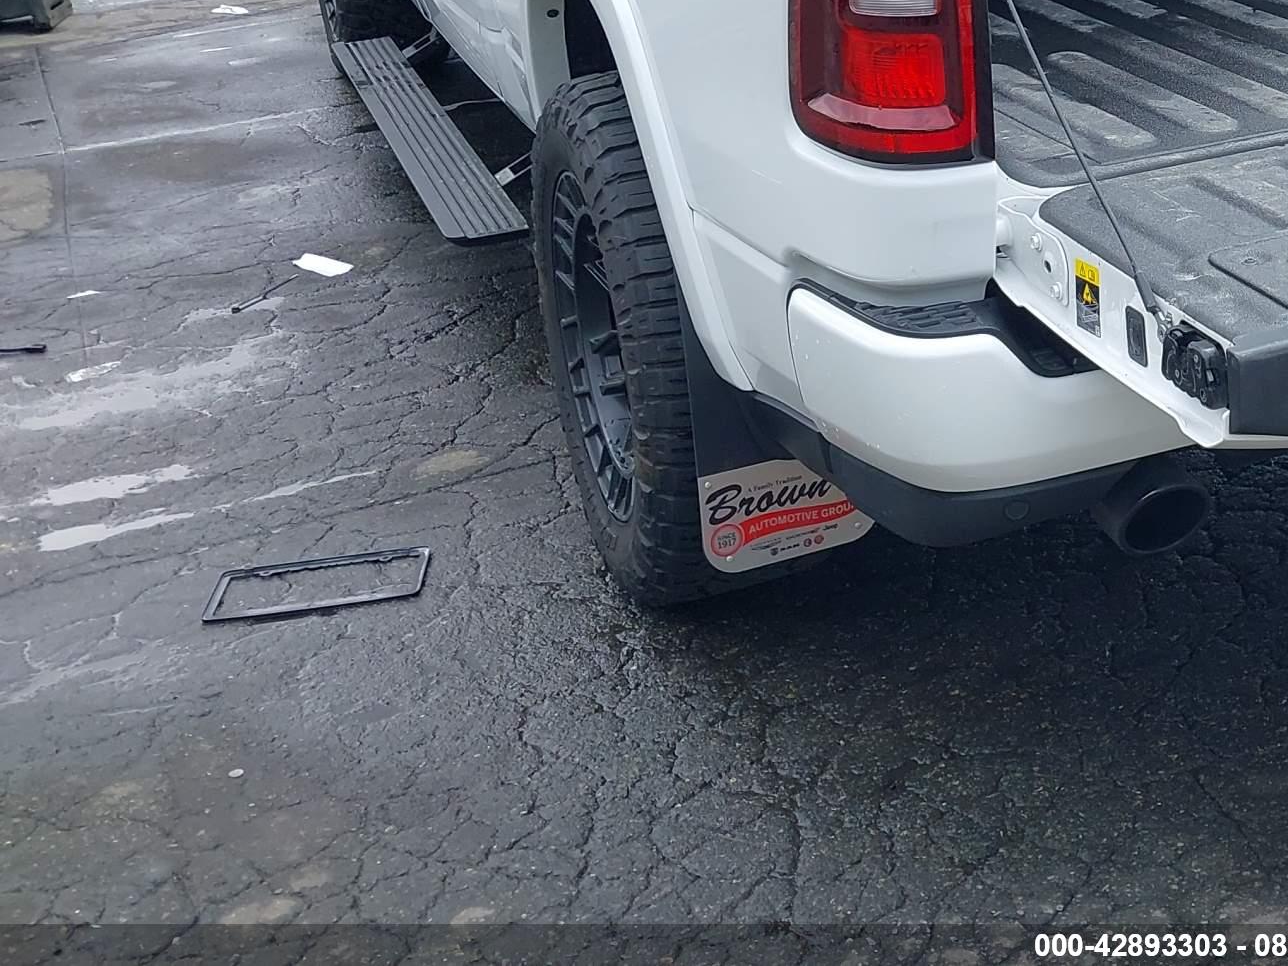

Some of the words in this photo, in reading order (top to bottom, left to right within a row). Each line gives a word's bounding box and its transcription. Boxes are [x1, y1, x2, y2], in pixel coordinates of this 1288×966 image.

[705, 479, 832, 526] Brown
[749, 510, 819, 534] AUTOMOTIVE
[821, 502, 854, 517] GROU
[717, 537, 737, 550] 1917
